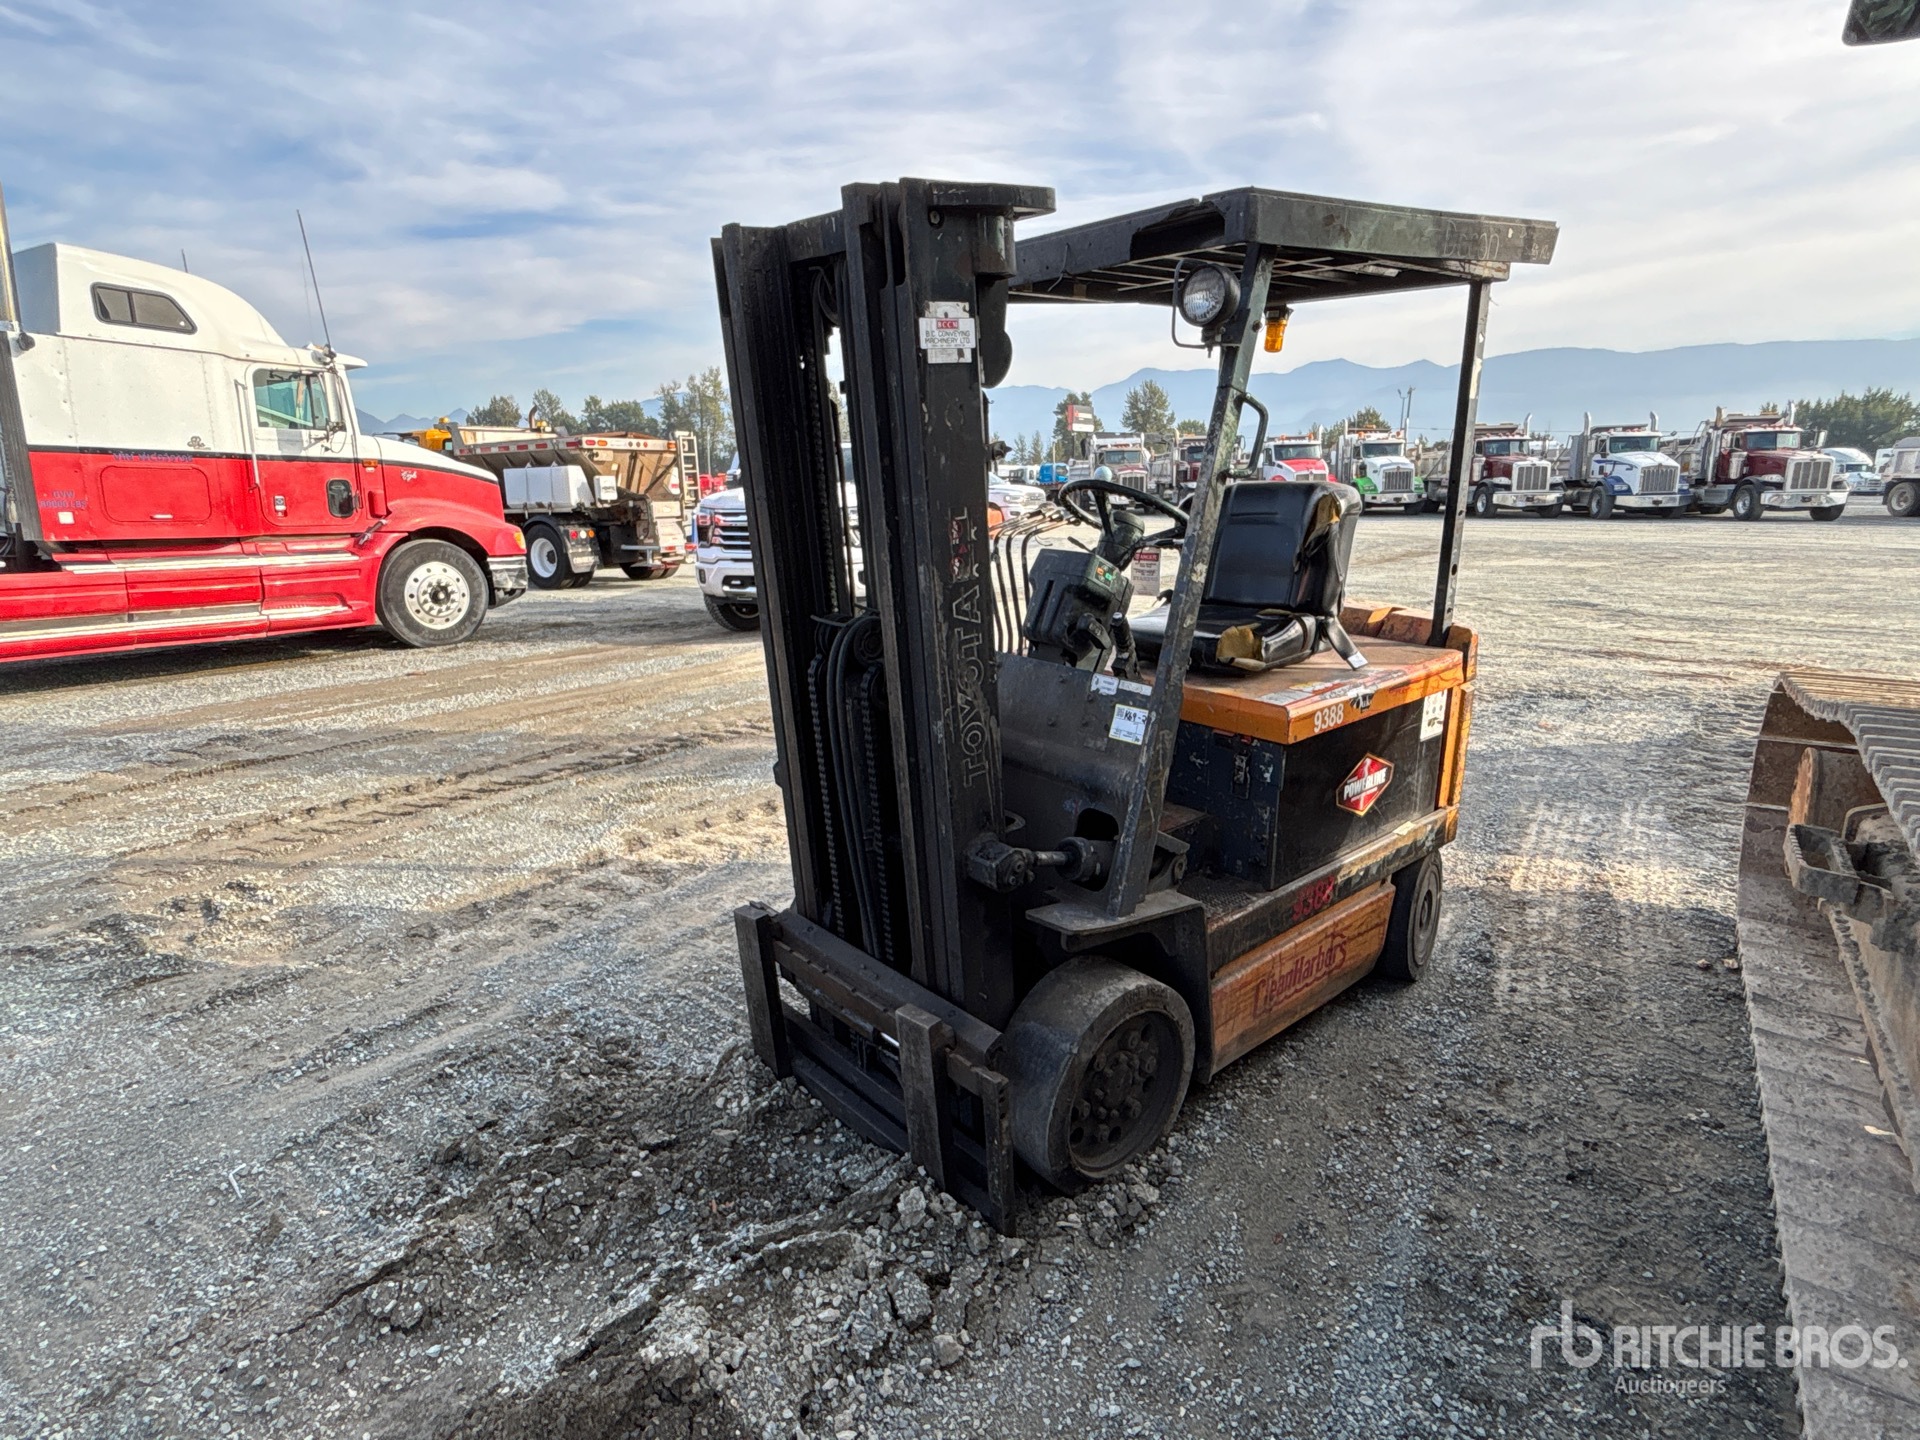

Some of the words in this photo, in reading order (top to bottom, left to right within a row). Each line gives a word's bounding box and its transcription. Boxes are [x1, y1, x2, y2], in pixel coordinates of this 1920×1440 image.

[938, 330, 970, 338] CONVEYING
[953, 585, 988, 788] TOYOTA
[1314, 703, 1344, 731] 9388
